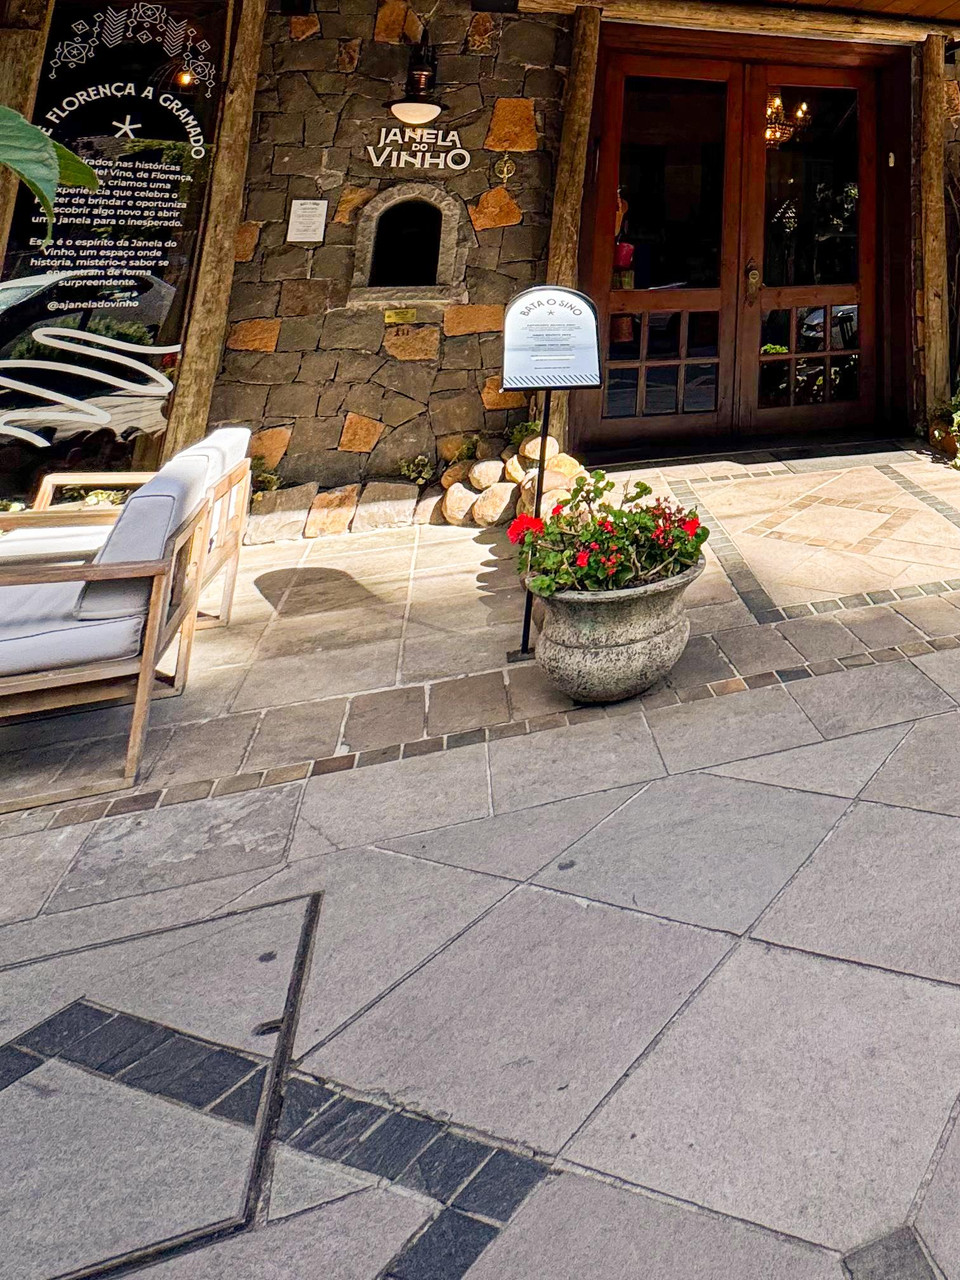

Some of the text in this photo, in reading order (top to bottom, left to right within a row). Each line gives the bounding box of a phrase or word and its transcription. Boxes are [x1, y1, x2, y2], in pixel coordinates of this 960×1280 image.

[37, 82, 206, 159] E FLORENÇA A GRAMADO
[377, 127, 462, 148] JANELA
[411, 143, 428, 151] DO
[366, 145, 471, 170] VINHO
[115, 160, 133, 168] nas
[135, 160, 181, 172] históricas
[110, 168, 134, 178] Vino,
[136, 170, 149, 179] de
[151, 171, 194, 183] Florença,
[108, 179, 148, 188] criamos
[112, 189, 133, 198] que
[134, 189, 170, 198] celebra
[72, 196, 86, 204] de
[88, 196, 127, 206] brindar
[135, 200, 187, 209] oportuniza
[92, 206, 115, 216] algo
[157, 209, 181, 218] abrir
[57, 215, 91, 225] janela
[93, 217, 117, 227] para
[127, 217, 184, 228] inesperado.
[29, 237, 54, 246] Ese
[56, 237, 64, 246] é
[75, 238, 114, 247] espírito
[116, 239, 129, 247] da
[131, 239, 162, 248] Janela
[164, 240, 177, 248] do
[43, 247, 77, 257] Vinho,
[99, 249, 136, 258] espaço
[137, 248, 162, 257] onde
[30, 257, 74, 267] história,
[75, 257, 119, 266] mistério
[129, 258, 156, 267] sabor
[122, 268, 152, 276] forma
[58, 278, 138, 288] surpreendente.
[47, 300, 139, 311] @ajaneladovinho
[520, 298, 583, 316] BATA O SINO
